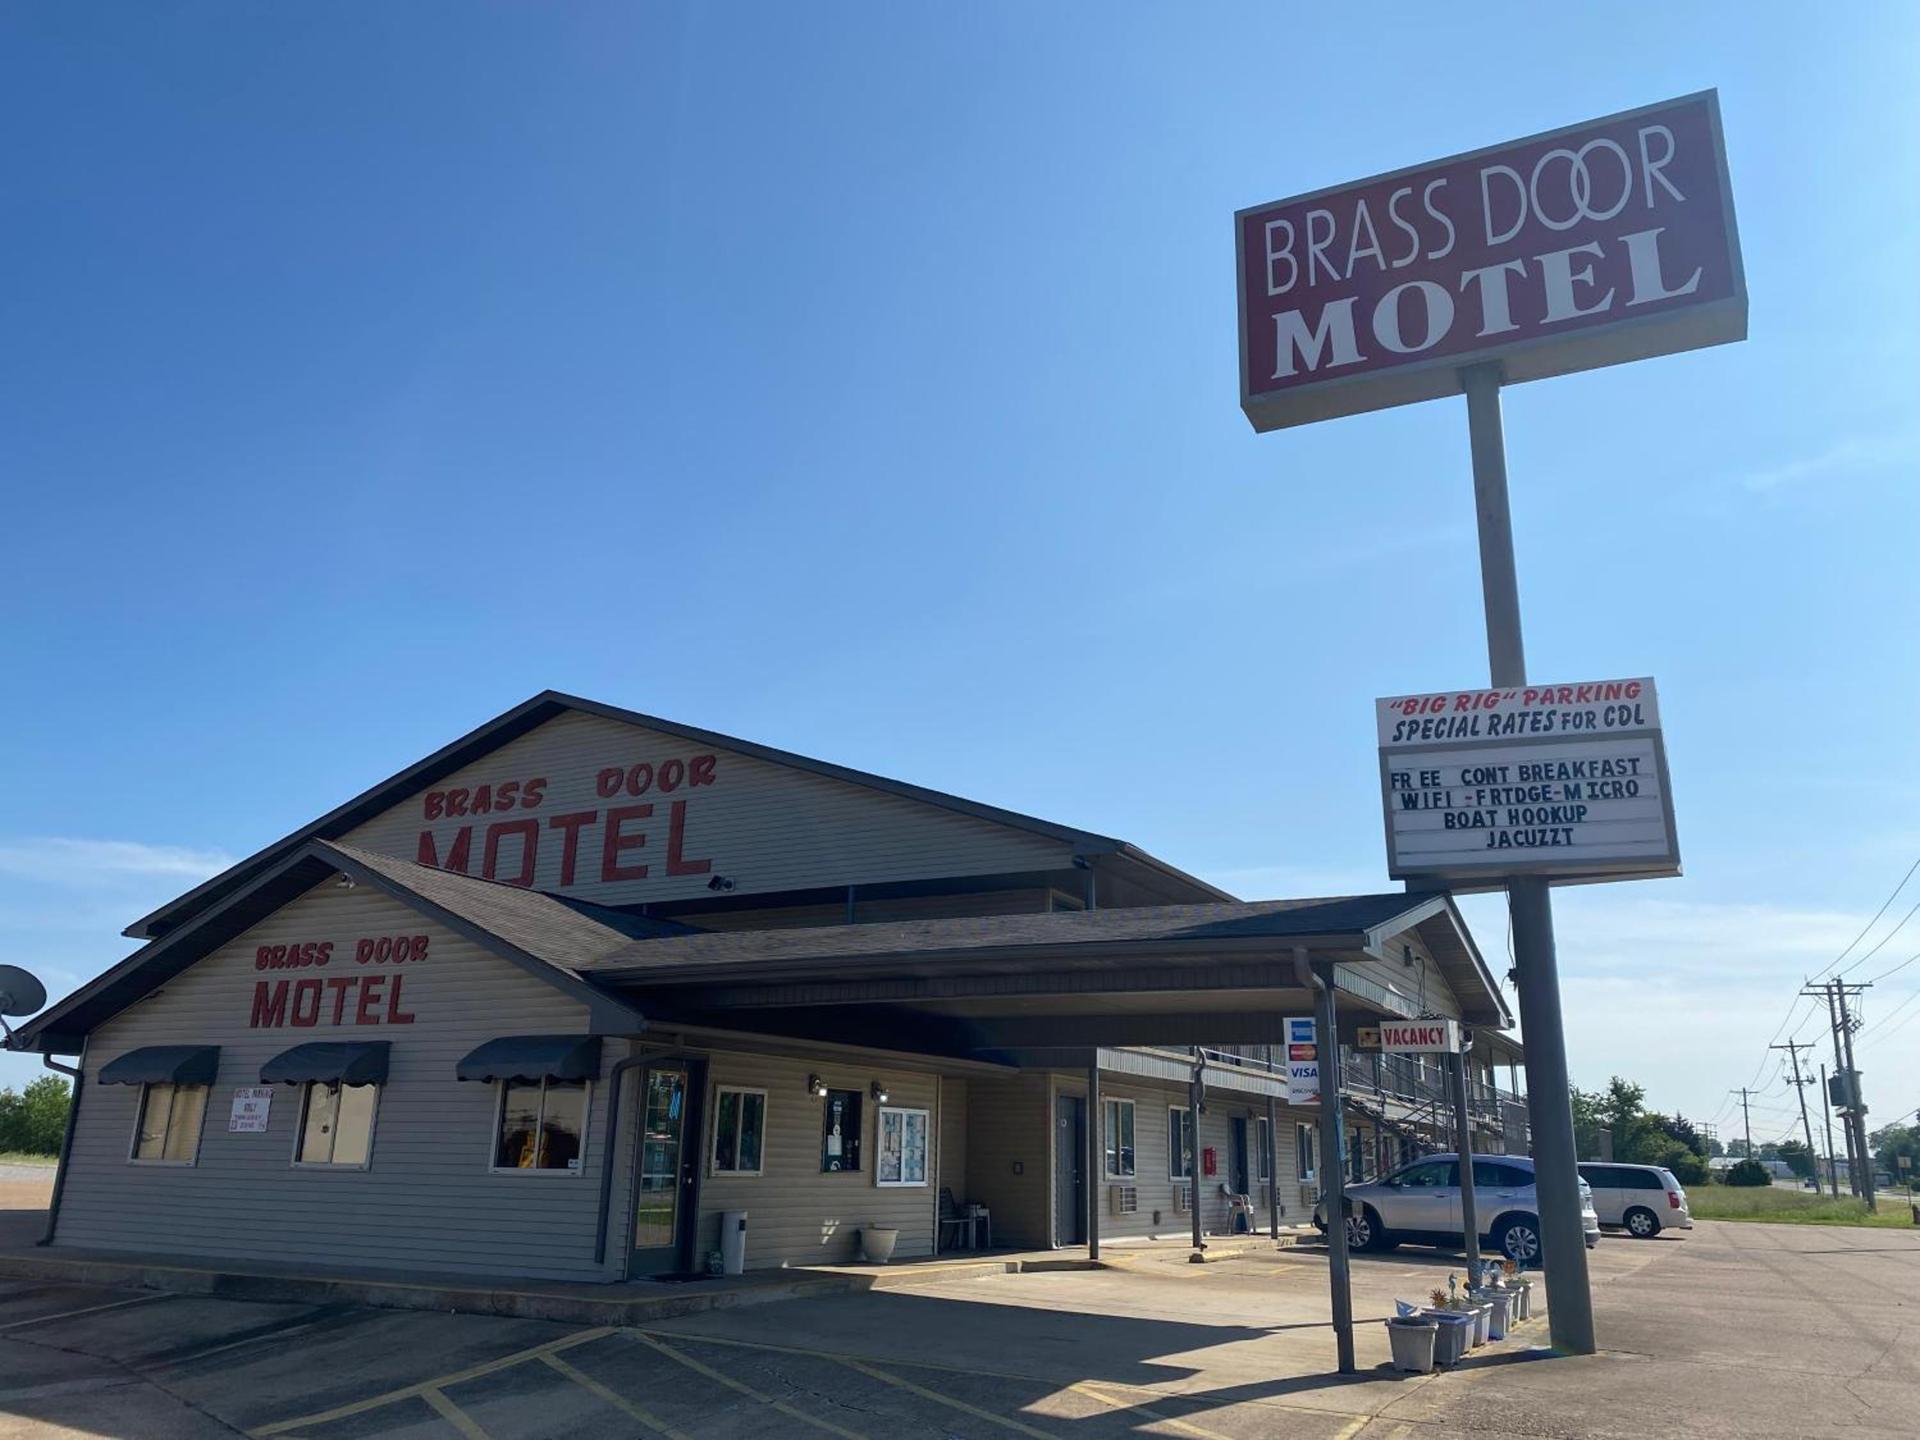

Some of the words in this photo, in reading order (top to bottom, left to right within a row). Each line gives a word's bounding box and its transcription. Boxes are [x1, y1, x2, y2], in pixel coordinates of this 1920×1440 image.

[1264, 178, 1456, 297] BRASS
[1480, 125, 1686, 247] DOOR
[1270, 227, 1702, 380] MOTEL
[1522, 681, 1642, 706] PARKING
[1392, 714, 1481, 742] SPECIAL
[1487, 709, 1557, 737] RATES
[1561, 710, 1597, 731] FOR
[1603, 703, 1645, 728] CDL
[424, 777, 548, 821] BRASS
[595, 754, 717, 799] DOOR
[1390, 770, 1441, 790] FREE
[1461, 766, 1509, 786] CONT
[1518, 757, 1640, 782] BREAKFAST
[1401, 790, 1452, 810] WIFI
[1444, 809, 1497, 830] BOAT
[1507, 804, 1588, 826] HOOKUP
[255, 941, 334, 971] BRASS
[355, 935, 430, 965] DOOR
[249, 974, 415, 1029] MOTEL
[1383, 1027, 1445, 1046] VACANCY
[1291, 1067, 1318, 1078] VISA
